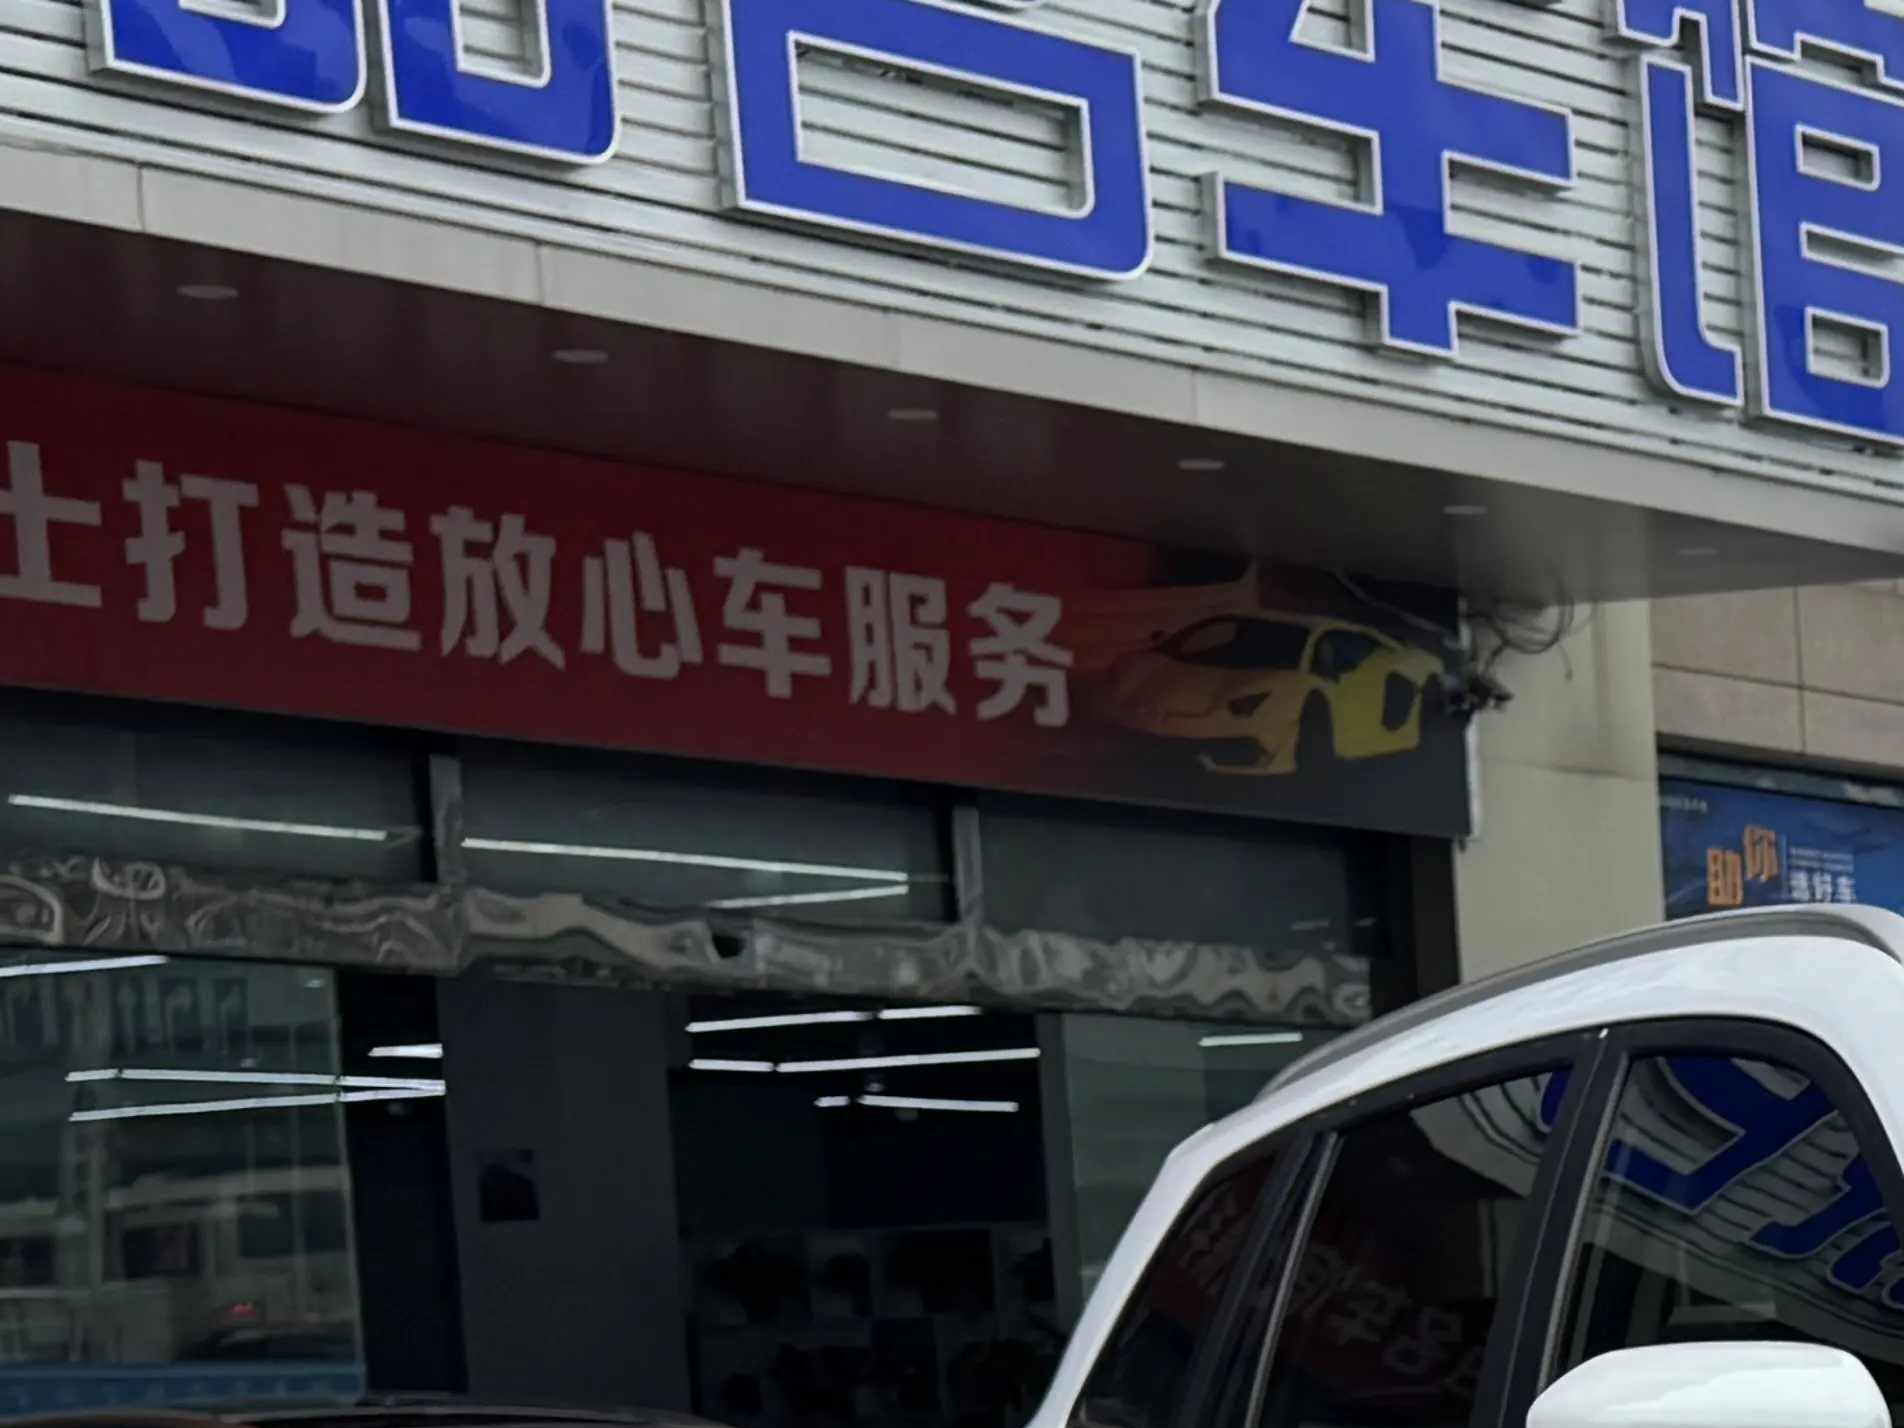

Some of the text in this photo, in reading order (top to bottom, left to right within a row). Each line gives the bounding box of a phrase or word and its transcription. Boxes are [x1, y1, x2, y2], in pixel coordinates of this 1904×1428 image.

[0, 440, 1076, 728] 士打造放心车服务
